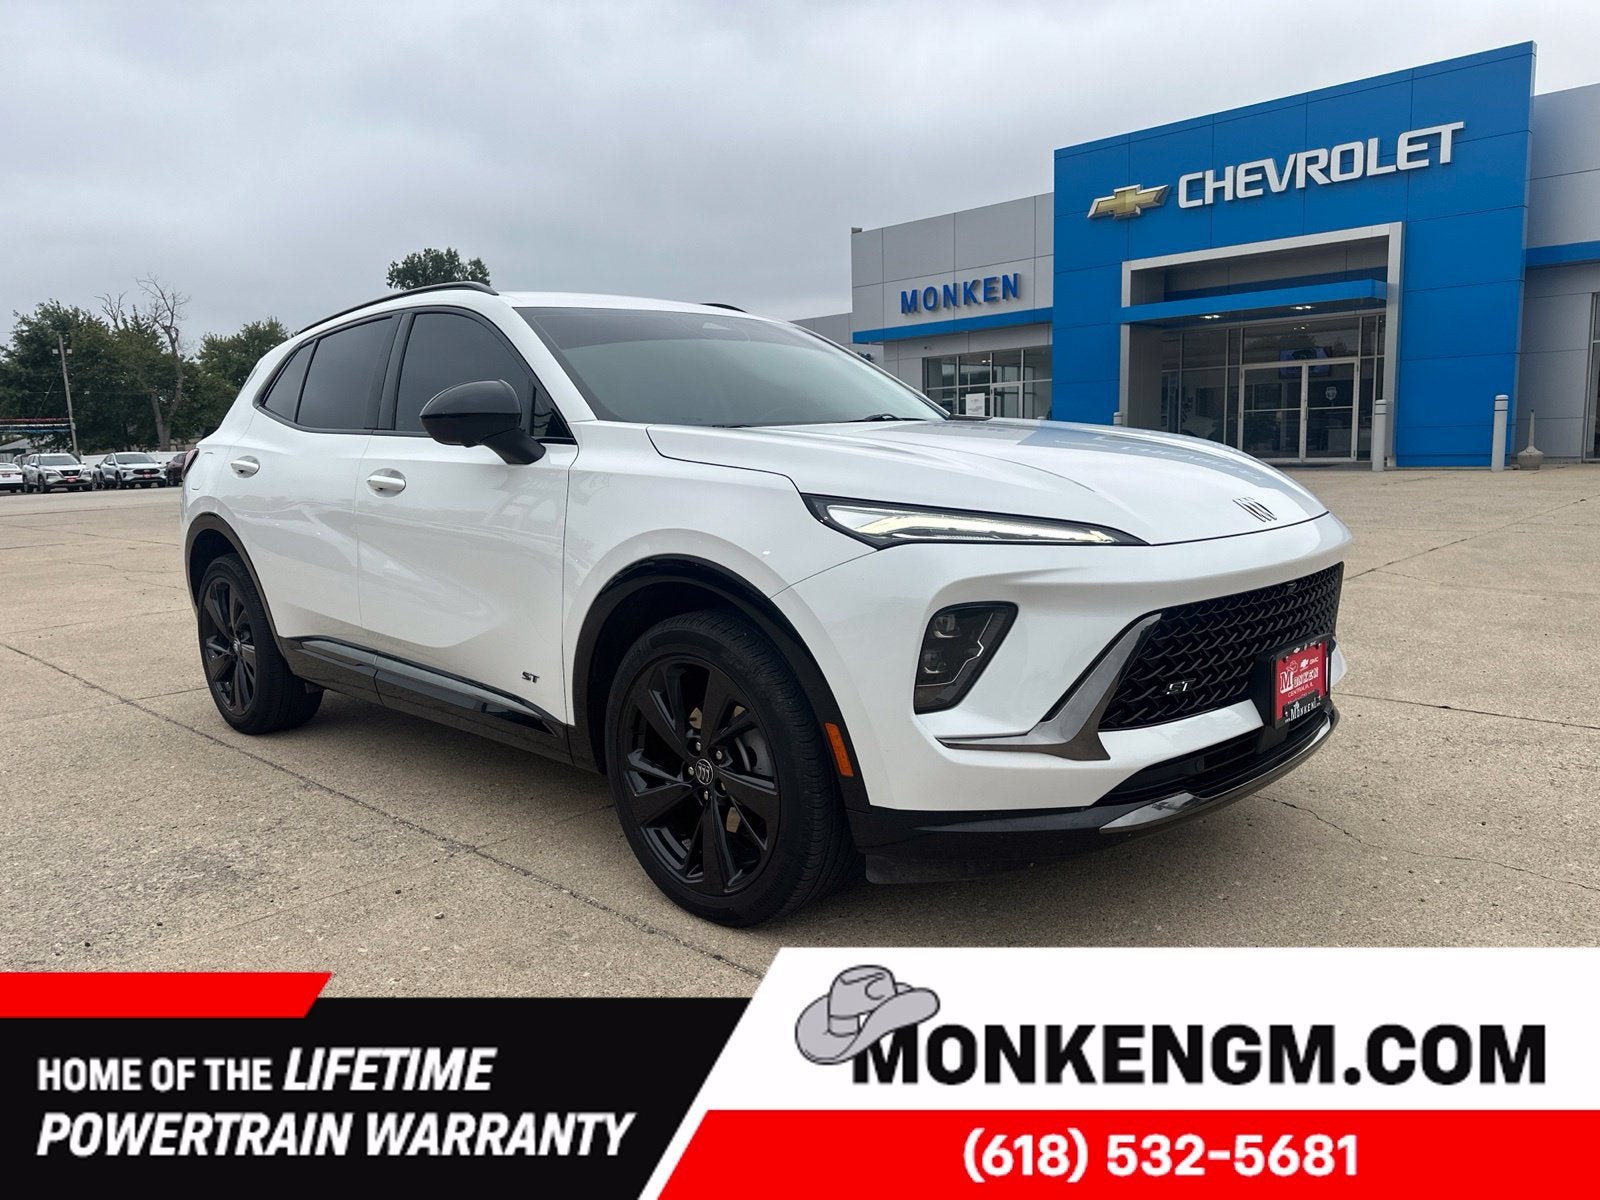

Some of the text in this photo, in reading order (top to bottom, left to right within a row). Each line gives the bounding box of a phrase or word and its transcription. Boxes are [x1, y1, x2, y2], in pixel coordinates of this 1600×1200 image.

[1178, 121, 1465, 209] CHEVROLET
[900, 273, 1020, 314] MONKEN
[521, 671, 540, 684] ST
